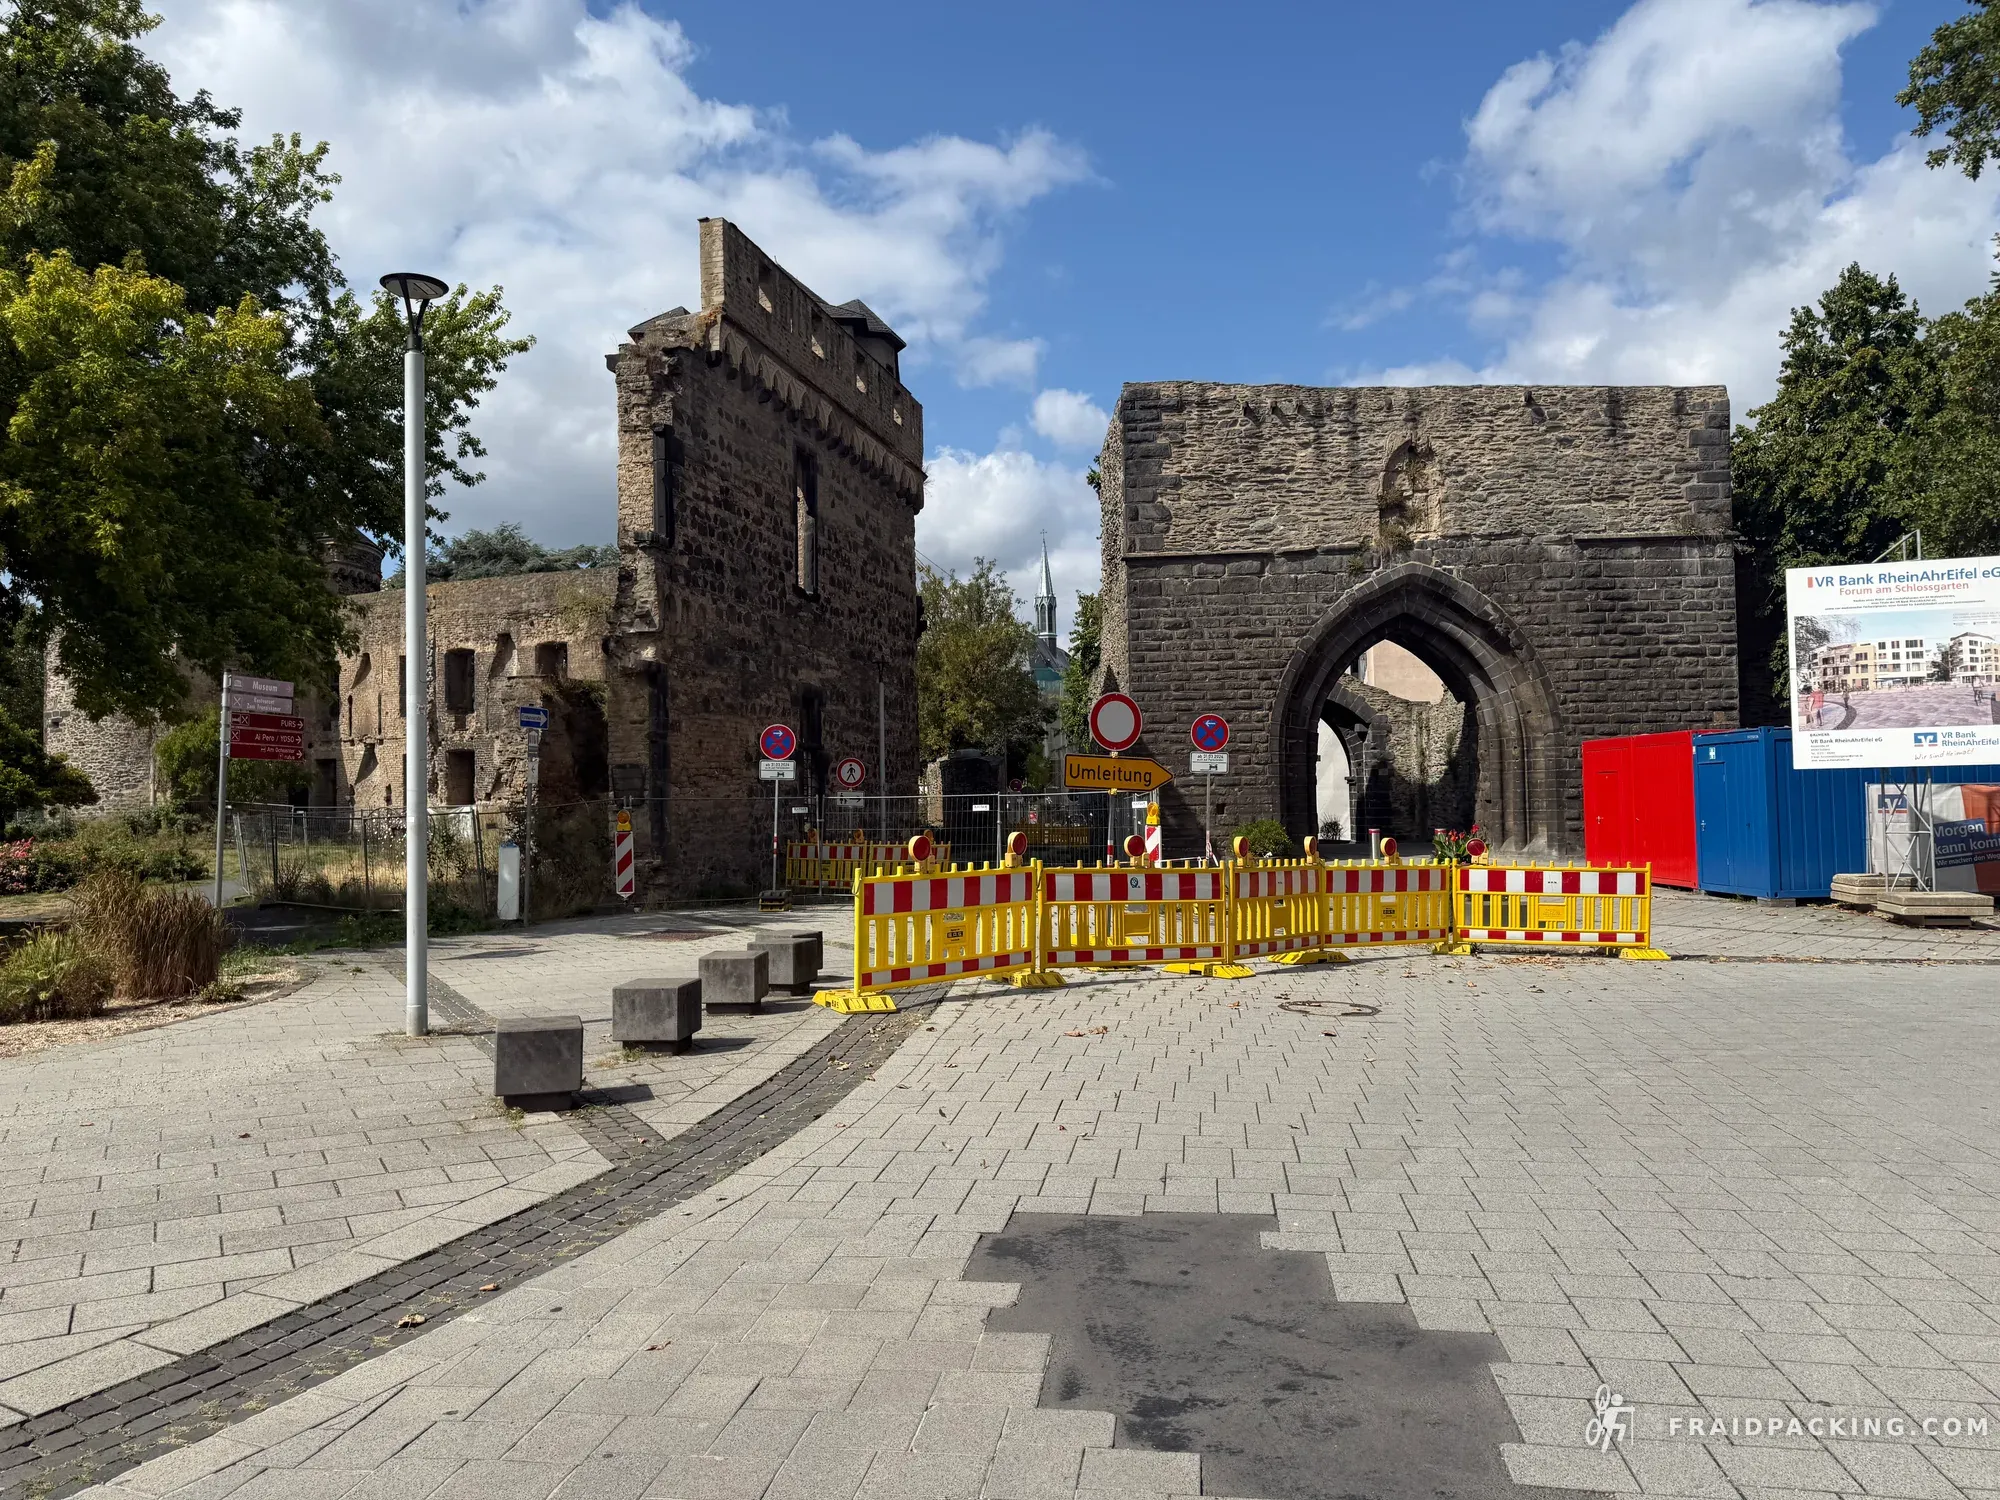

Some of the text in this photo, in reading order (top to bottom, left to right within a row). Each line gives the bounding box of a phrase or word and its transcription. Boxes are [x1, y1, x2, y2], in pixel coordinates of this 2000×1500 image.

[1815, 577, 1834, 588] VR
[1839, 573, 1873, 586] Bank
[1878, 567, 1977, 584] RheinAhrEifel
[1839, 581, 1969, 596] Forum am Schlossgarten
[252, 680, 278, 692] Museum
[280, 719, 296, 728] PURS
[1941, 731, 1976, 739] VR Bank
[1942, 738, 1999, 747] RheinAhrEifel
[1929, 751, 1945, 759] sind
[1069, 763, 1152, 787] Umleitung
[1933, 823, 1984, 838] Morgen
[1934, 842, 1967, 855] kann
[1973, 854, 1986, 862] den
